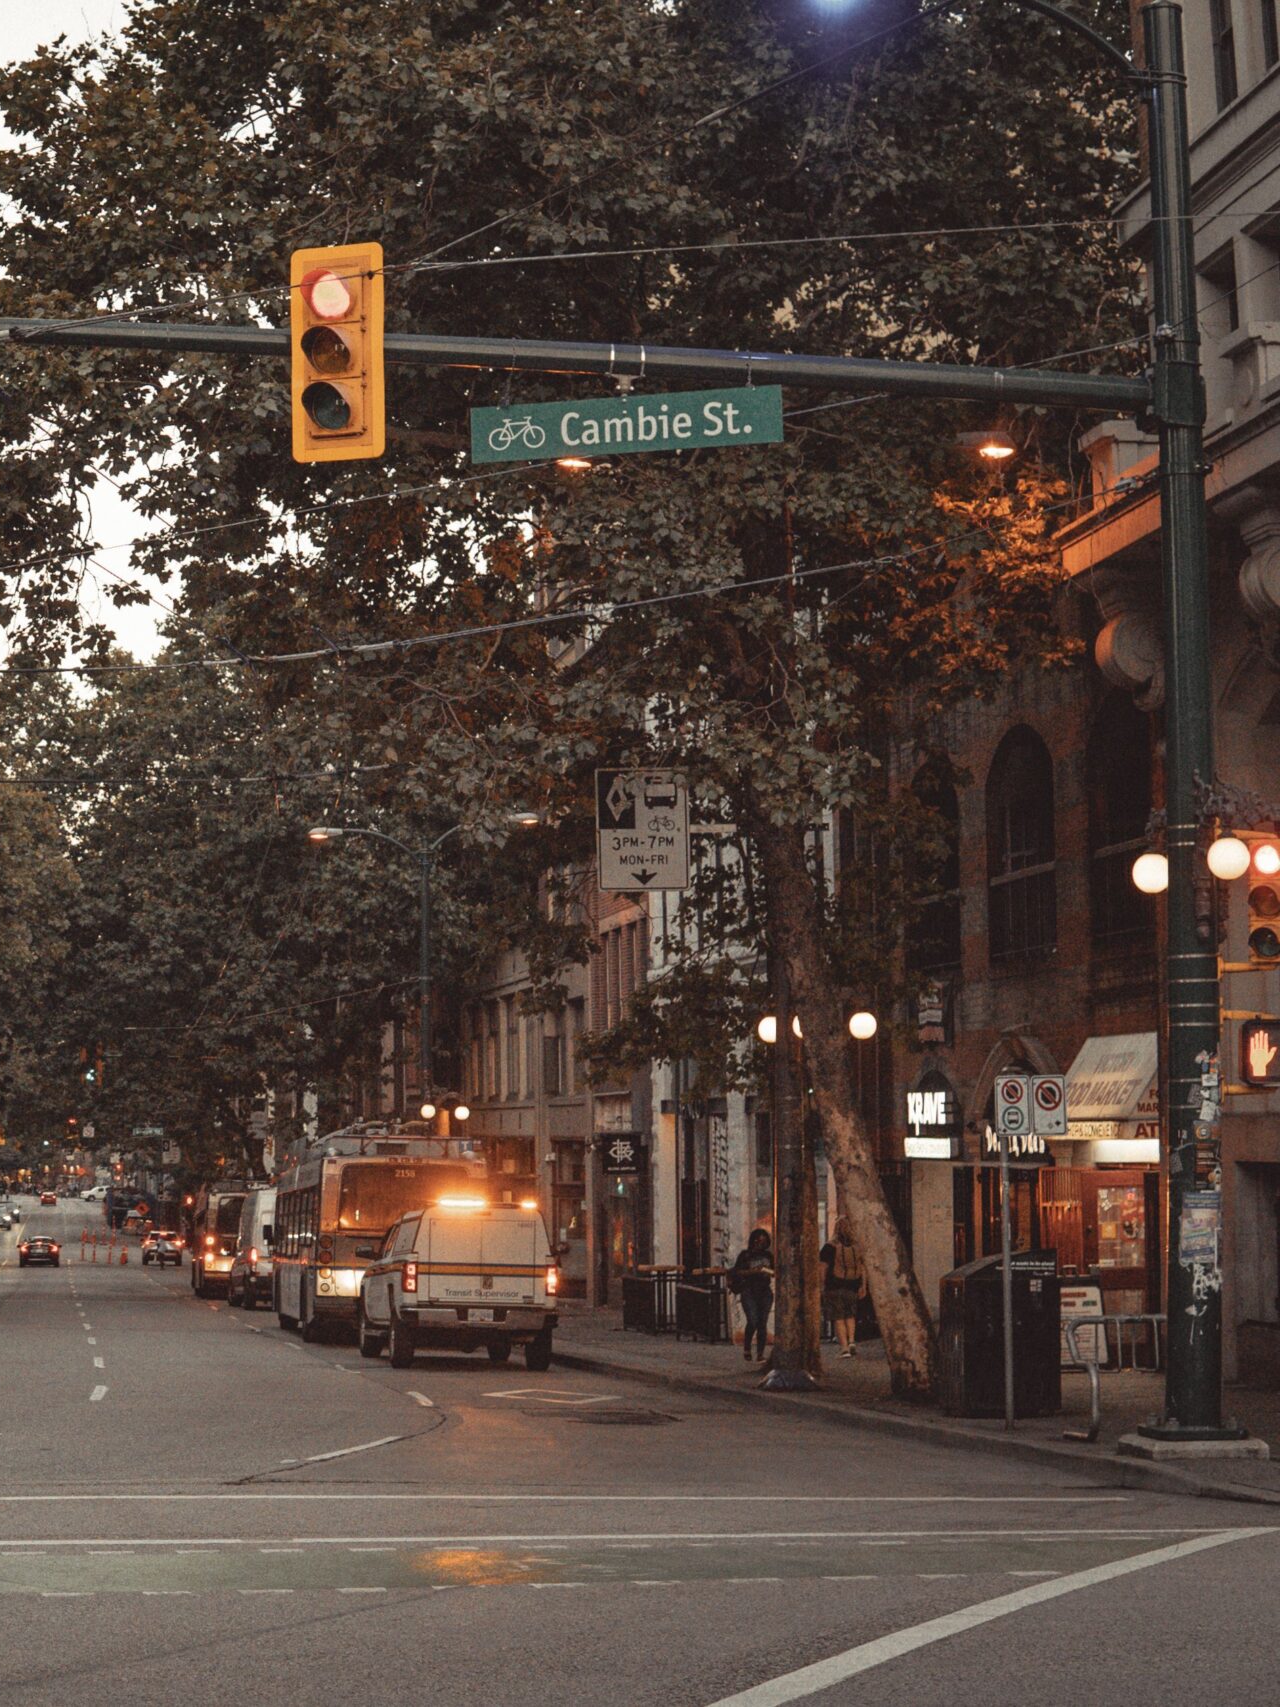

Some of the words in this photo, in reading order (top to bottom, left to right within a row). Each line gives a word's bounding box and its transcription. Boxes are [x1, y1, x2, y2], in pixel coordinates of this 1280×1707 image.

[560, 404, 692, 447] Cambie
[703, 401, 753, 437] St.
[620, 854, 668, 865] MON-FRI
[1085, 1078, 1143, 1106] MARKET
[1137, 1102, 1159, 1113] MAR
[1134, 1122, 1159, 1139] AT
[444, 1288, 472, 1297] Transit
[474, 1288, 519, 1299] Supervisor
